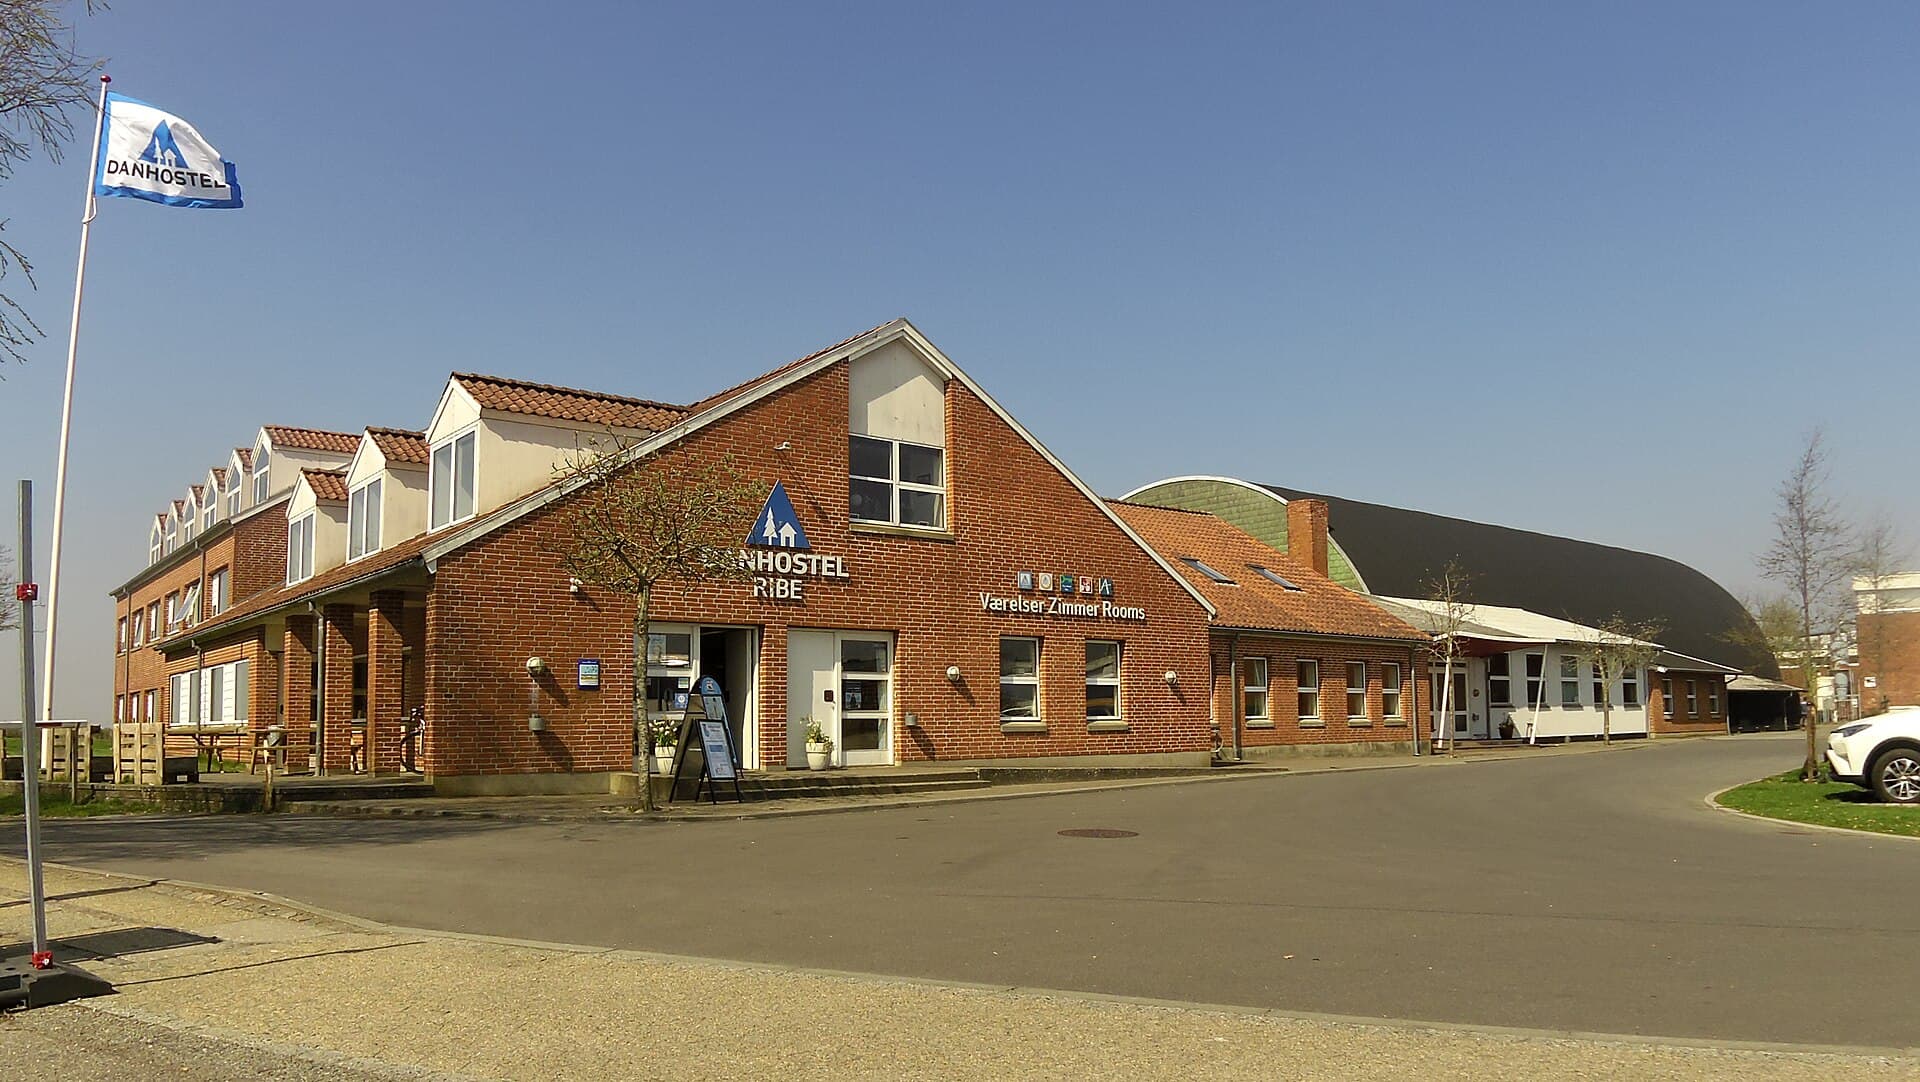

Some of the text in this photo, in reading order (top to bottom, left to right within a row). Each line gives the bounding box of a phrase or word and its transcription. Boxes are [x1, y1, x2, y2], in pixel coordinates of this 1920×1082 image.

[107, 160, 227, 188] DANHOSTEL
[703, 547, 849, 577] NHOSTEL
[753, 577, 803, 600] RIBE
[979, 592, 1146, 620] Værelser Zimmer Rooms
